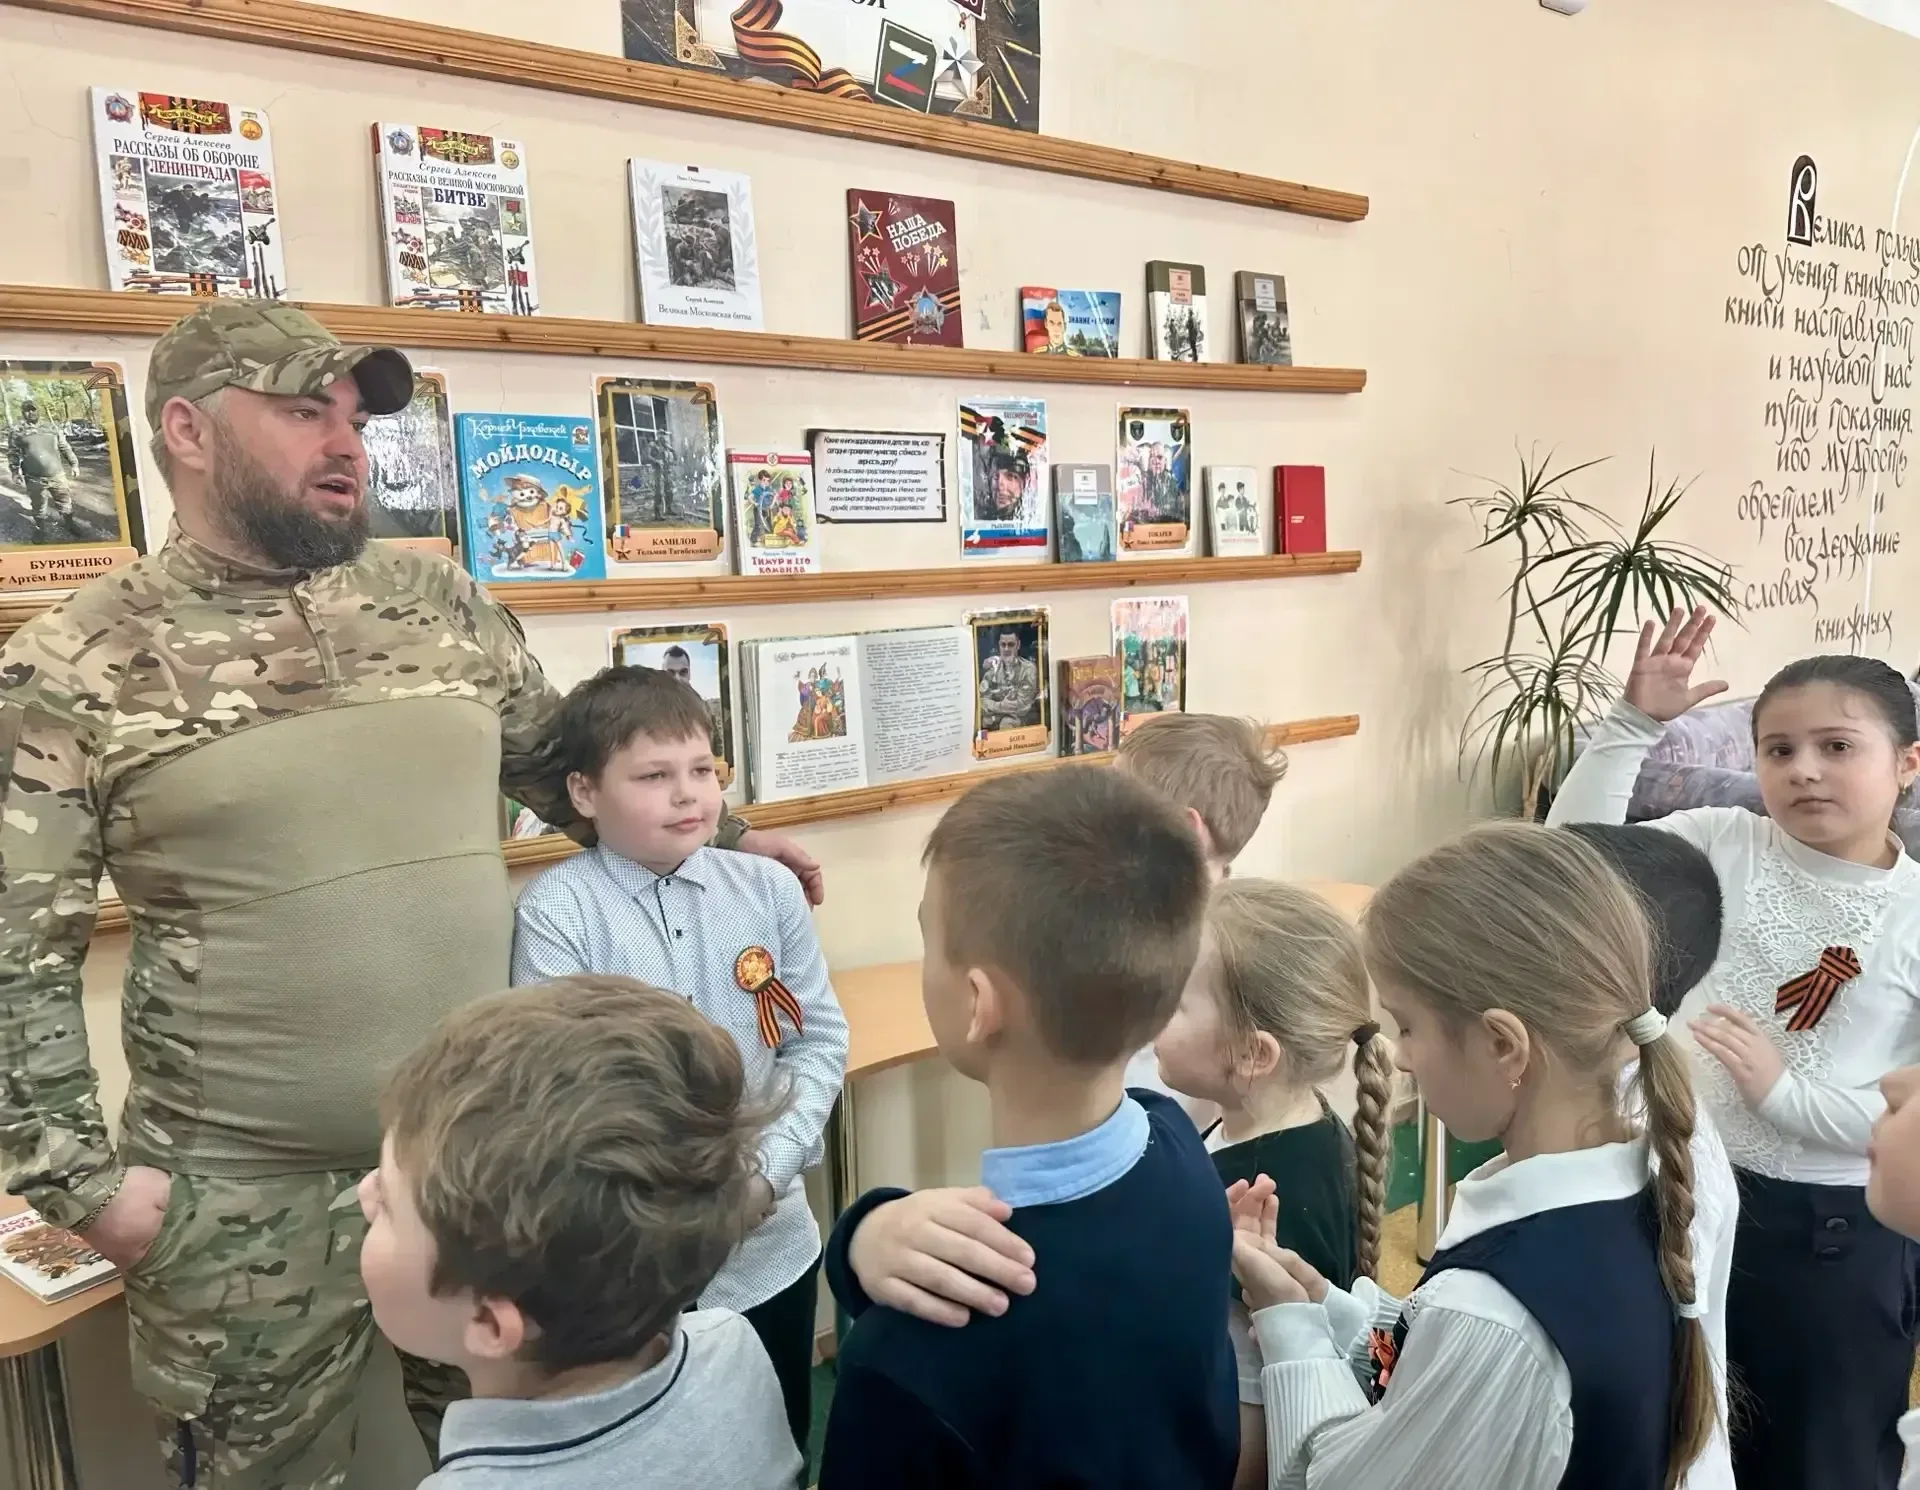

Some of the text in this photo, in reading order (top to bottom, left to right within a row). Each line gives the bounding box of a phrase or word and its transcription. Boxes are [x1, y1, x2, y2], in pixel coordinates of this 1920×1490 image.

[113, 138, 260, 169] РАССКАЗЫ ОБ ОБОРОНЕ
[144, 131, 231, 150] Сергей Алексеев
[149, 160, 232, 181] ЛЕНИНГРАДА
[388, 170, 524, 196] РАССКАЗЫ О ВЕЛИКОЙ МОСКОВСКОЙ
[419, 162, 497, 180] Сергей Алексеев
[434, 187, 486, 208] БИТВЕ
[886, 213, 927, 239] НАША
[891, 221, 947, 253] ПОБЕДА
[1775, 243, 1840, 308] учения
[1844, 267, 1920, 317] книжного
[658, 304, 752, 321] Великая Московская битва
[1725, 295, 1916, 365] книги наставляют
[1769, 348, 1912, 404] и научают нас
[1765, 388, 1819, 446] пути
[470, 443, 592, 481] МОЙДОДЫР
[1777, 437, 1907, 503] ибо мудрость
[1737, 480, 1885, 545] обретаем и
[652, 537, 697, 546] КАМИЛОВ
[30, 556, 113, 570] БУРЯЧЕНКО
[8, 573, 46, 586] Артём
[1745, 567, 1819, 619] словах
[1815, 603, 1893, 656] книжных
